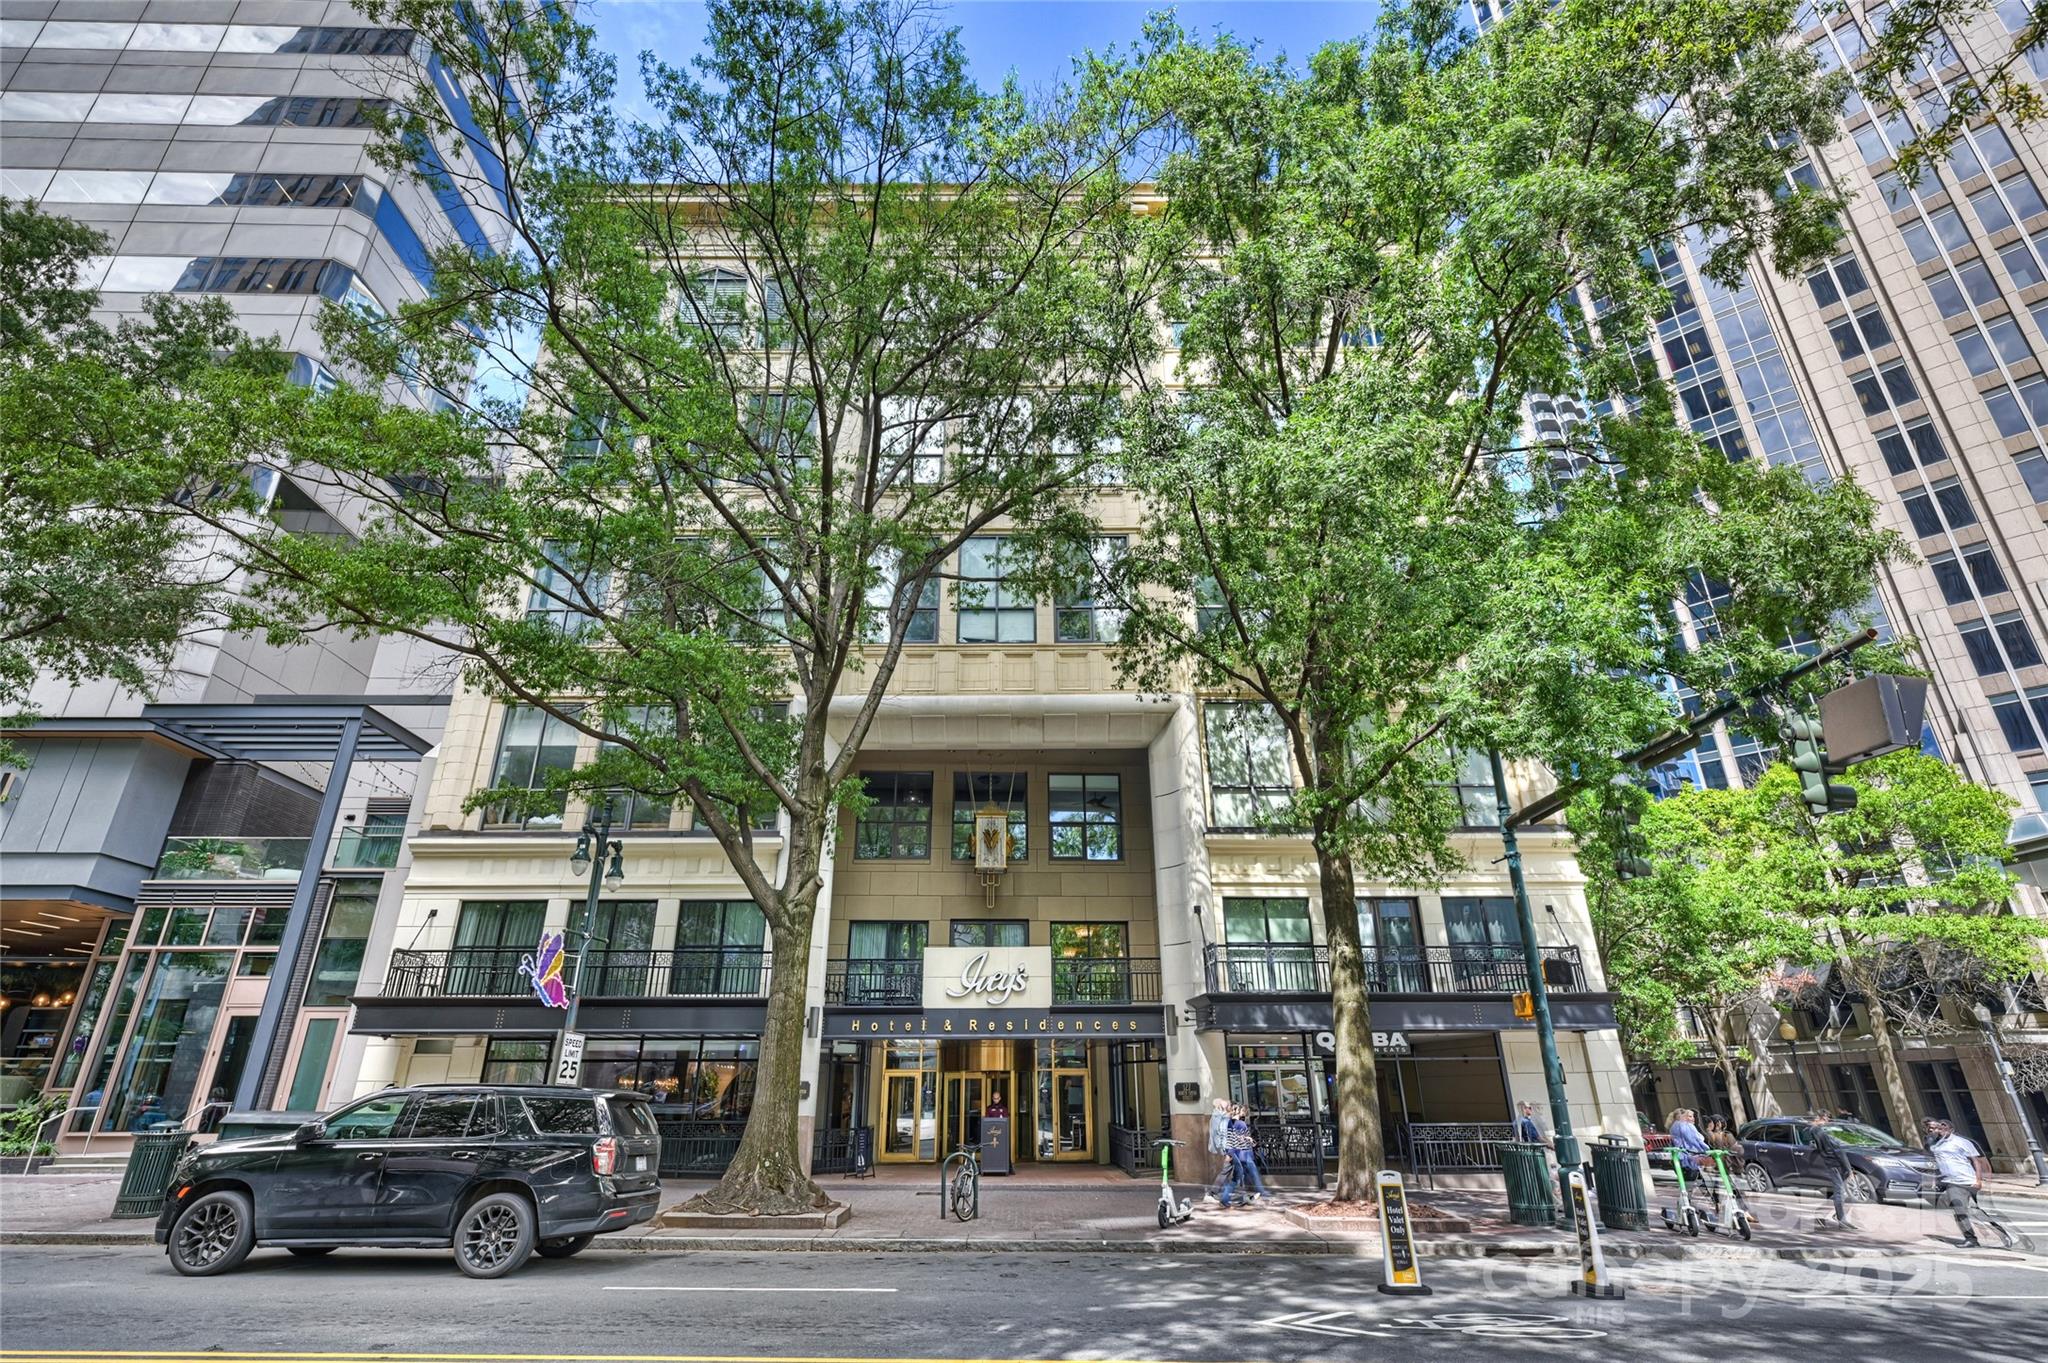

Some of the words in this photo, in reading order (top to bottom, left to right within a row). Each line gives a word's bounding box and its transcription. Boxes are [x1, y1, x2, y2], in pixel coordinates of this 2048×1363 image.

[945, 951, 1028, 1005] Ivey's
[851, 1019, 926, 1032] Hotel
[943, 1019, 952, 1031] &
[969, 1018, 1137, 1031] Residences
[565, 1038, 582, 1048] SPEED
[1316, 1031, 1408, 1052] QBA
[565, 1049, 579, 1058] LIMIT
[559, 1060, 578, 1079] 25
[1387, 1206, 1403, 1215] Hotel
[1388, 1216, 1405, 1225] Valet
[1390, 1226, 1406, 1236] Only
